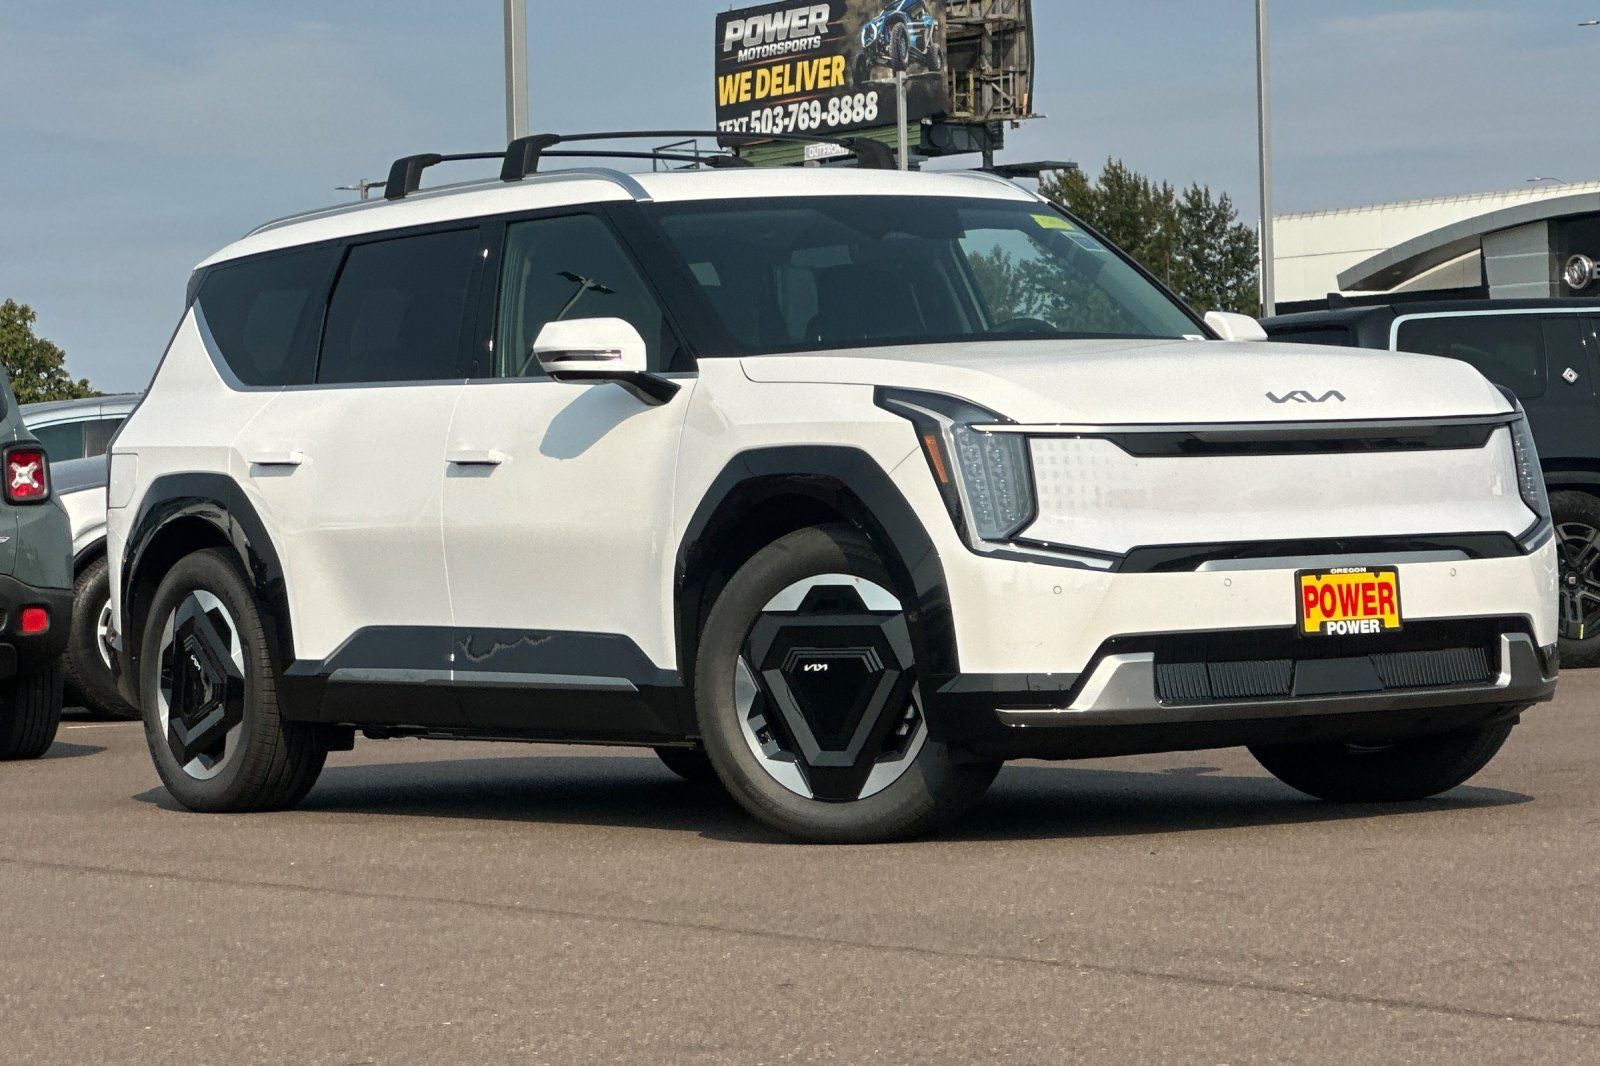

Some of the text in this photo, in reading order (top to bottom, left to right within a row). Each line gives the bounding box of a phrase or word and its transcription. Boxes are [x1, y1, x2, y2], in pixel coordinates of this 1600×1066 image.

[724, 4, 830, 52] POWER
[738, 36, 821, 62] MOTORSPORTS
[719, 55, 846, 106] WE DELIVER
[719, 91, 878, 135] TEXT 503-769-8888
[1303, 581, 1395, 618] POWER
[1327, 620, 1381, 635] POWER
